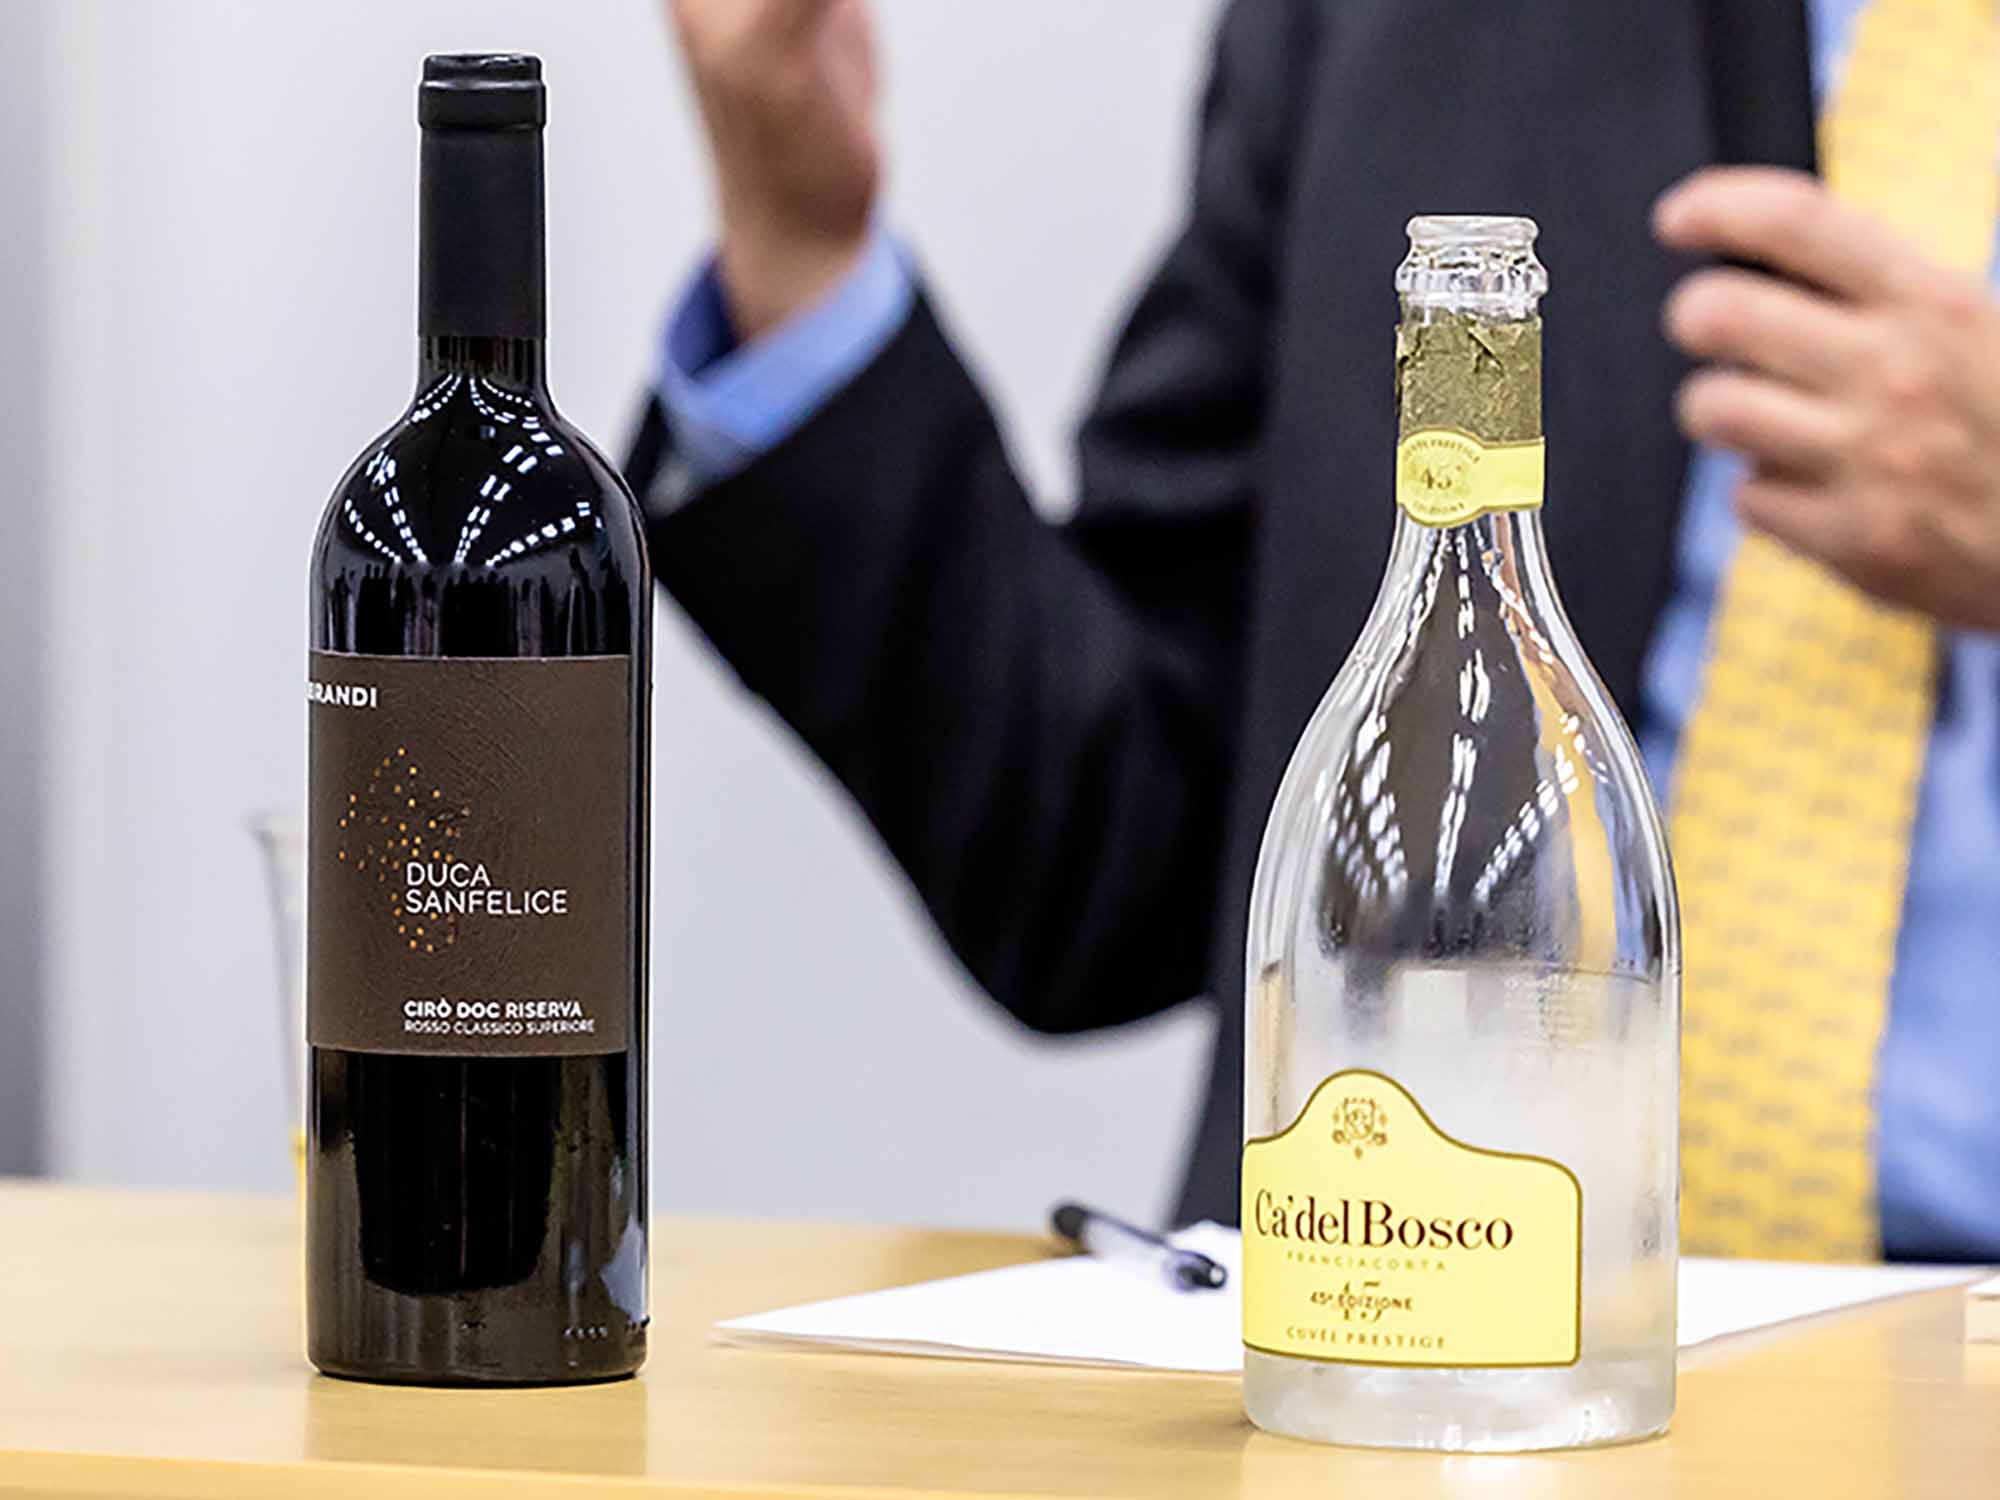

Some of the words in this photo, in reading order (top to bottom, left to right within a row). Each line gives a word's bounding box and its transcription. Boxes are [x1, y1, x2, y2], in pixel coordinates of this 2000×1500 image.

[406, 862, 491, 888] DUCA
[405, 889, 568, 914] SANFELICE
[404, 998, 452, 1018] CIRÒ
[456, 1002, 500, 1018] DOC
[505, 1001, 583, 1018] RISERVA
[404, 1020, 451, 1034] ROSSO
[453, 1021, 524, 1035] CLASSICO
[526, 1019, 595, 1034] SUPERIORE
[1361, 1199, 1514, 1250] Bosco
[1287, 1251, 1445, 1271] FRANCIACORTA
[1338, 1293, 1413, 1312] EDIZIONE
[1346, 1332, 1445, 1347] PRESTIGE
